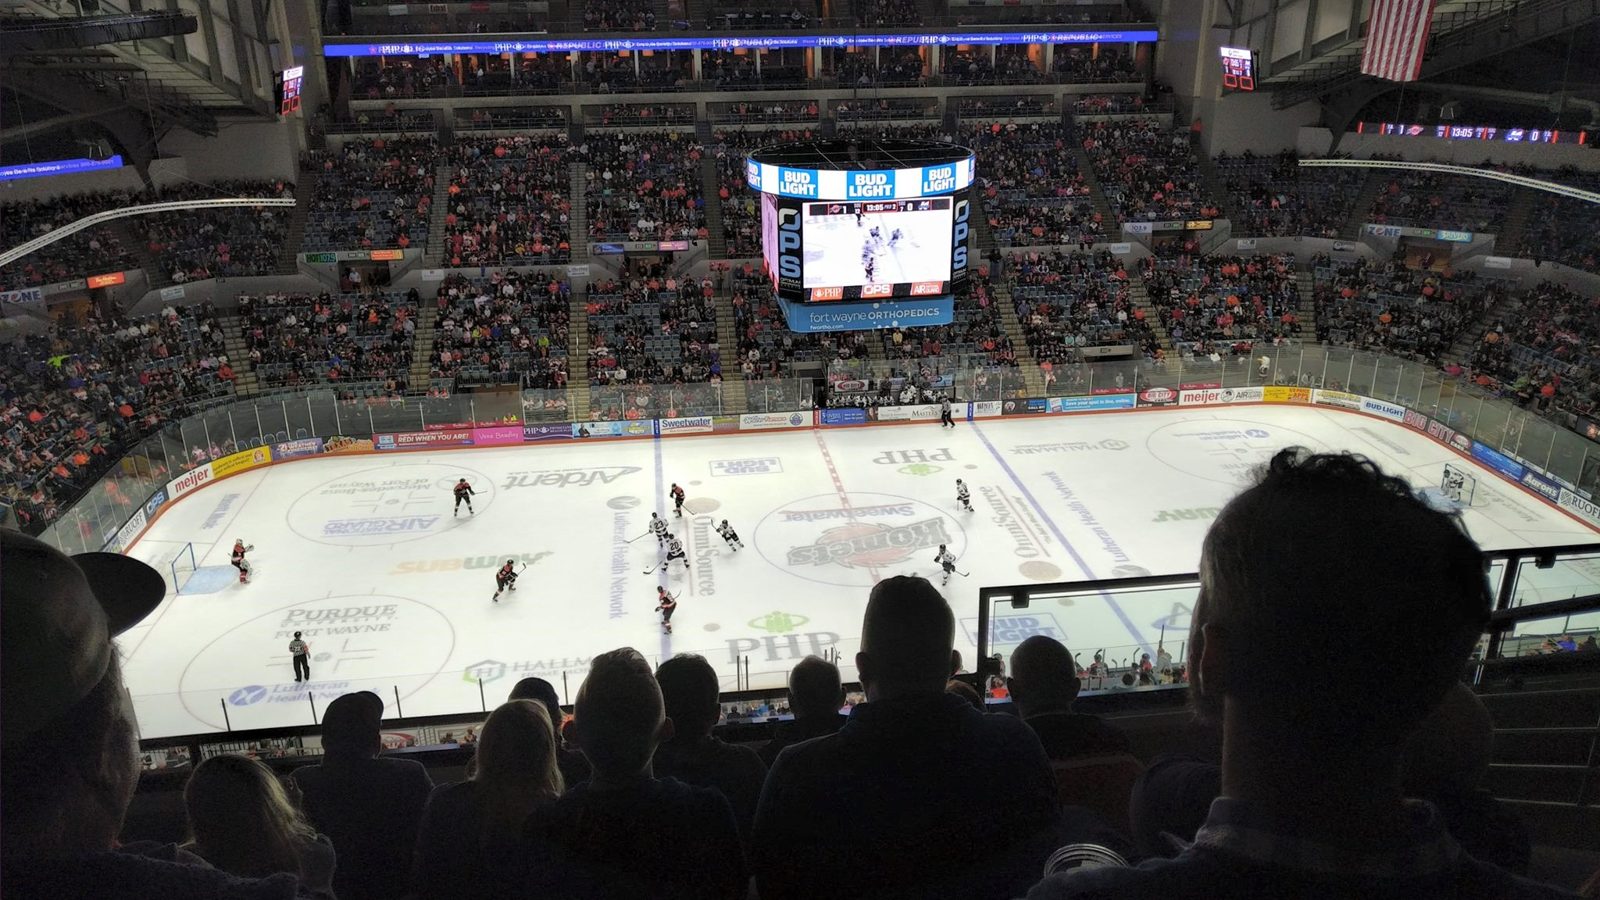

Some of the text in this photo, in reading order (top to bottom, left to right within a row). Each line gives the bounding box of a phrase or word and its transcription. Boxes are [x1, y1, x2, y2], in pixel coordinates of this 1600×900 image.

[819, 38, 836, 46] PHP
[1023, 34, 1039, 42] PHP
[495, 43, 512, 52] PHP
[605, 41, 622, 49] PHP
[1398, 124, 1404, 135] 1
[1452, 127, 1473, 137] 13:05
[1531, 131, 1539, 140] 0
[784, 170, 811, 184] BUD
[855, 173, 887, 186] BUD
[929, 167, 952, 181] BUD
[780, 181, 816, 196] LIGHT
[849, 185, 892, 197] LIGHT
[924, 177, 955, 193] LIGHT
[842, 205, 847, 214] 1
[867, 204, 884, 212] 13:05
[907, 202, 913, 211] 0
[953, 199, 969, 271] OPS
[779, 207, 801, 280] OPS
[824, 288, 842, 298] PHP
[864, 284, 890, 294] OPS
[914, 286, 925, 294] AIR
[810, 308, 940, 323] fort wayne ORTHOPEDICS
[1184, 391, 1220, 404] meijer
[1365, 402, 1403, 417] BUD LIGHT
[662, 417, 712, 428] Sweetwater
[1404, 409, 1427, 430] BIG
[1428, 420, 1455, 443] CITY
[496, 431, 519, 440] Bradley
[523, 427, 539, 435] PHP
[437, 434, 452, 442] YOU
[872, 448, 957, 465] PHP
[714, 459, 777, 470] LIGHT
[723, 465, 770, 474] BUD
[174, 468, 209, 493] meijer
[146, 492, 165, 514] OPS
[783, 506, 917, 523] Sweetwater
[1041, 471, 1131, 563] Lutheran Health Network
[385, 516, 440, 532] AIR
[653, 520, 664, 530] 23
[669, 541, 680, 551] 20
[286, 604, 399, 622] PURDUE
[274, 624, 392, 640] FORT WAYNE
[725, 631, 841, 665] PHP
[513, 656, 592, 672] HALLM
[271, 682, 350, 694] Lutheran
